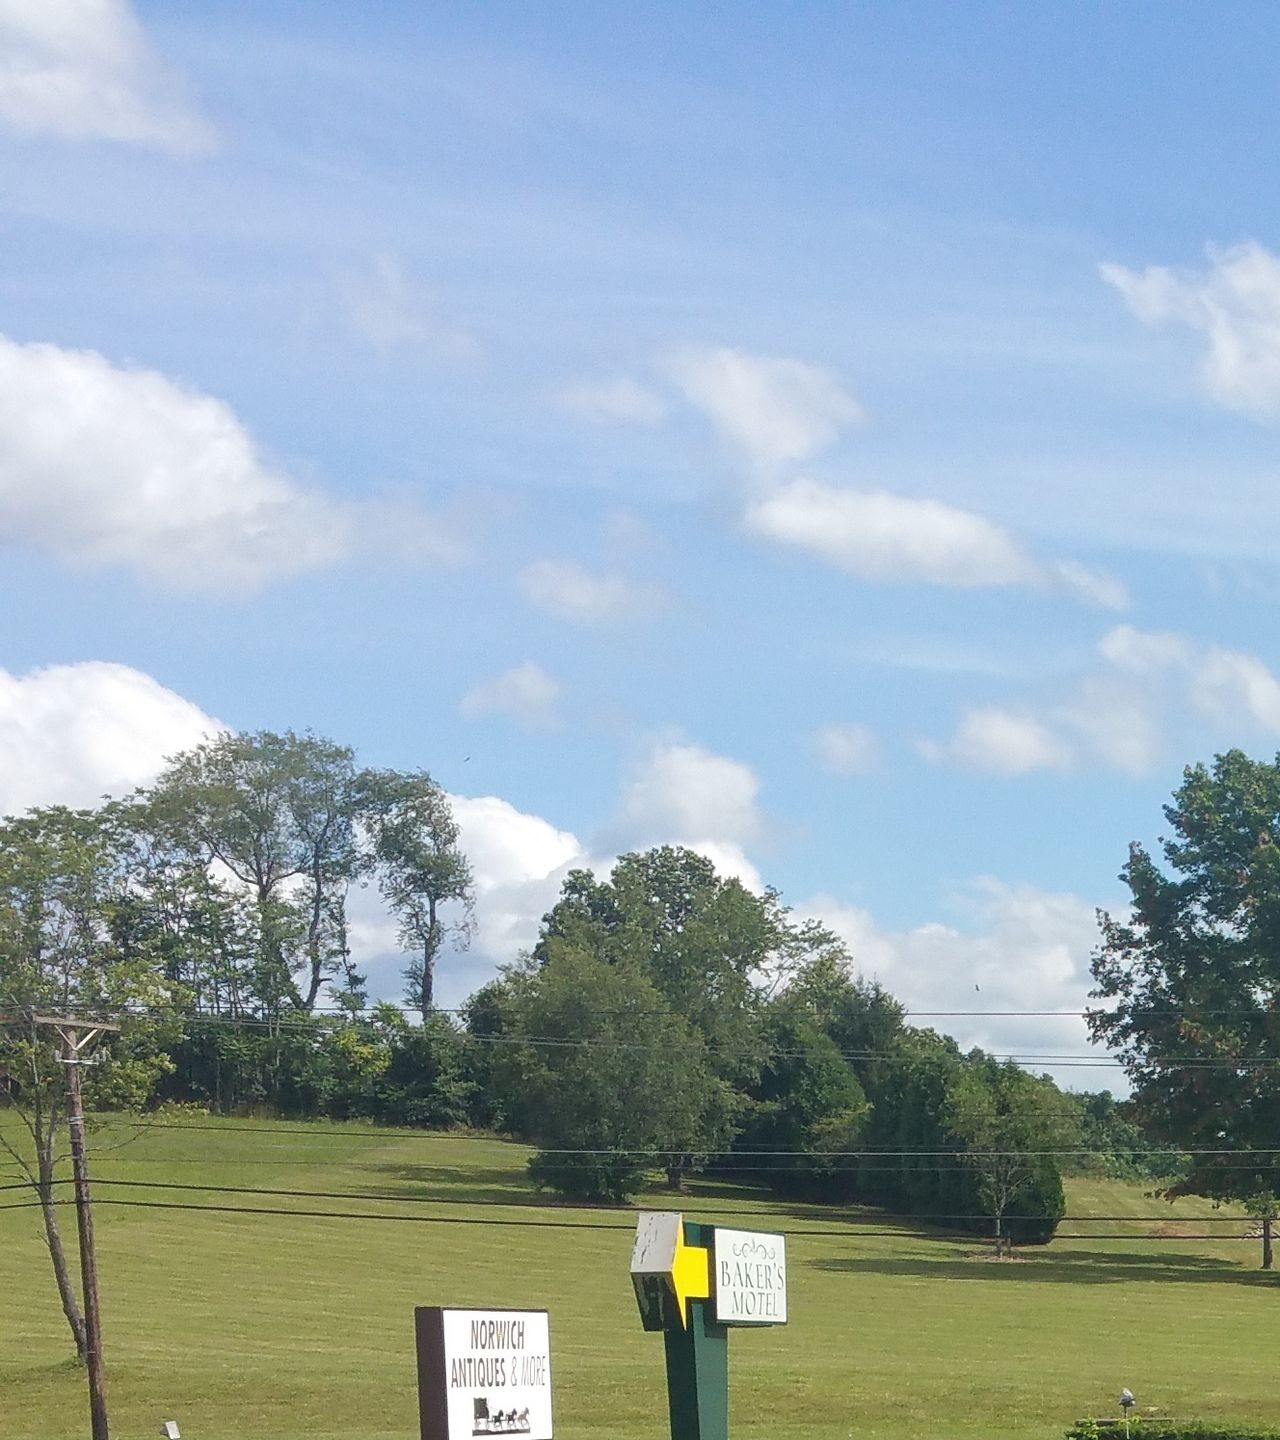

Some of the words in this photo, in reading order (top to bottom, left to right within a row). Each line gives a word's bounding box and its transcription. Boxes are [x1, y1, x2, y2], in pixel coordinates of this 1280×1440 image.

[721, 1261, 785, 1291] BAKER'S
[731, 1291, 779, 1317] MOTEL
[470, 1320, 525, 1350] NORWICH
[450, 1357, 506, 1389] ANTIQUES
[510, 1356, 518, 1387] &
[520, 1355, 546, 1387] MORE
